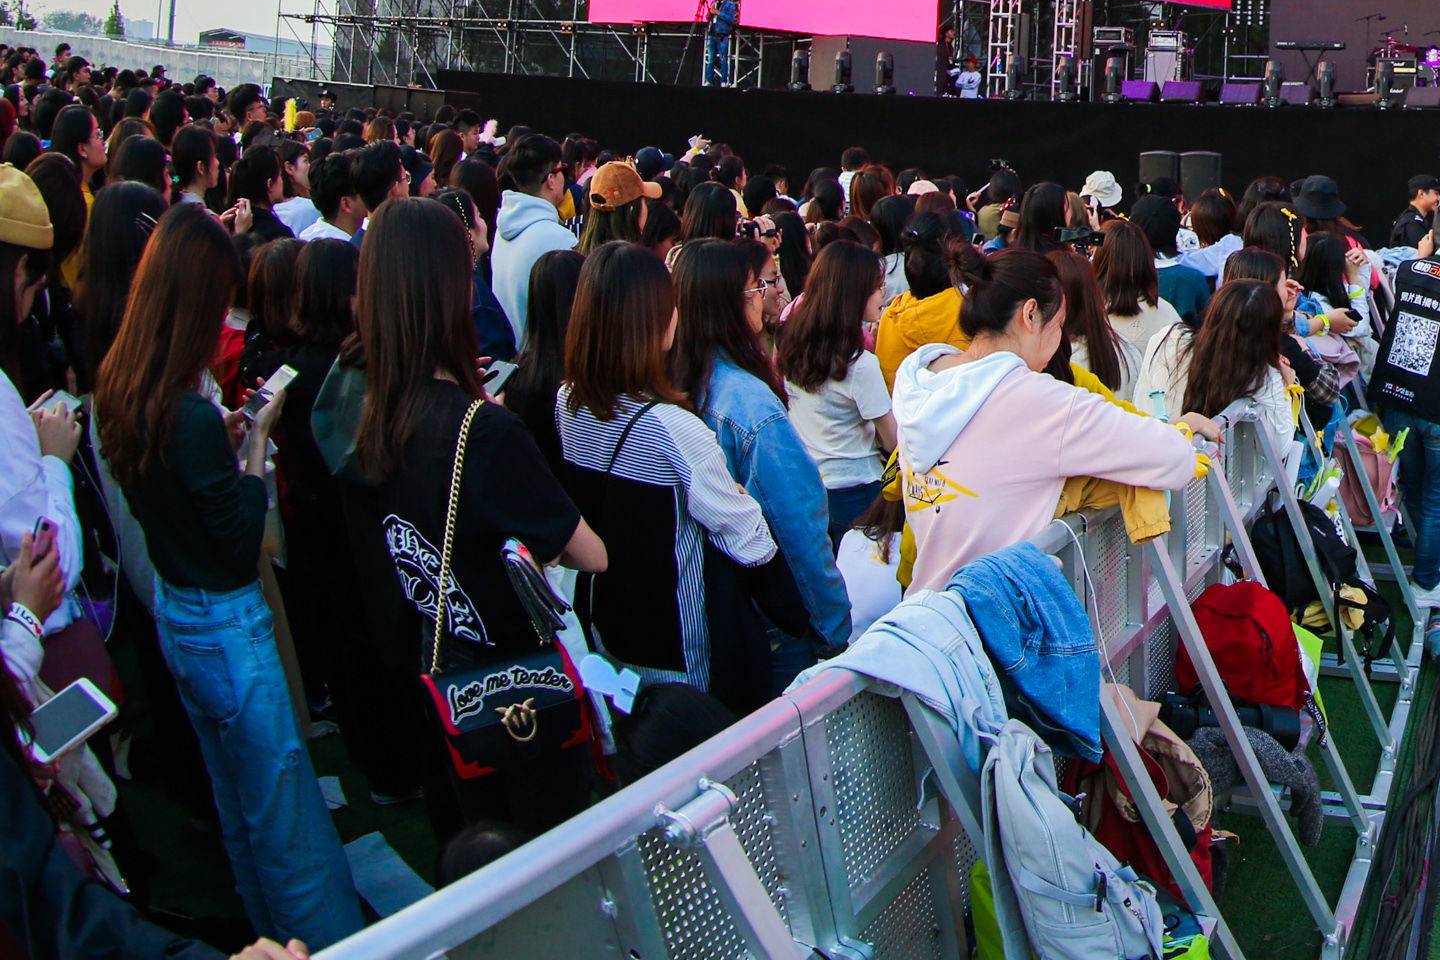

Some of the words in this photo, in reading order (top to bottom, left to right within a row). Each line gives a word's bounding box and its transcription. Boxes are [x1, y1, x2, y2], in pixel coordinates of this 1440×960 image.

[449, 682, 483, 722] Love
[485, 673, 511, 693] me
[511, 667, 571, 689] tender
